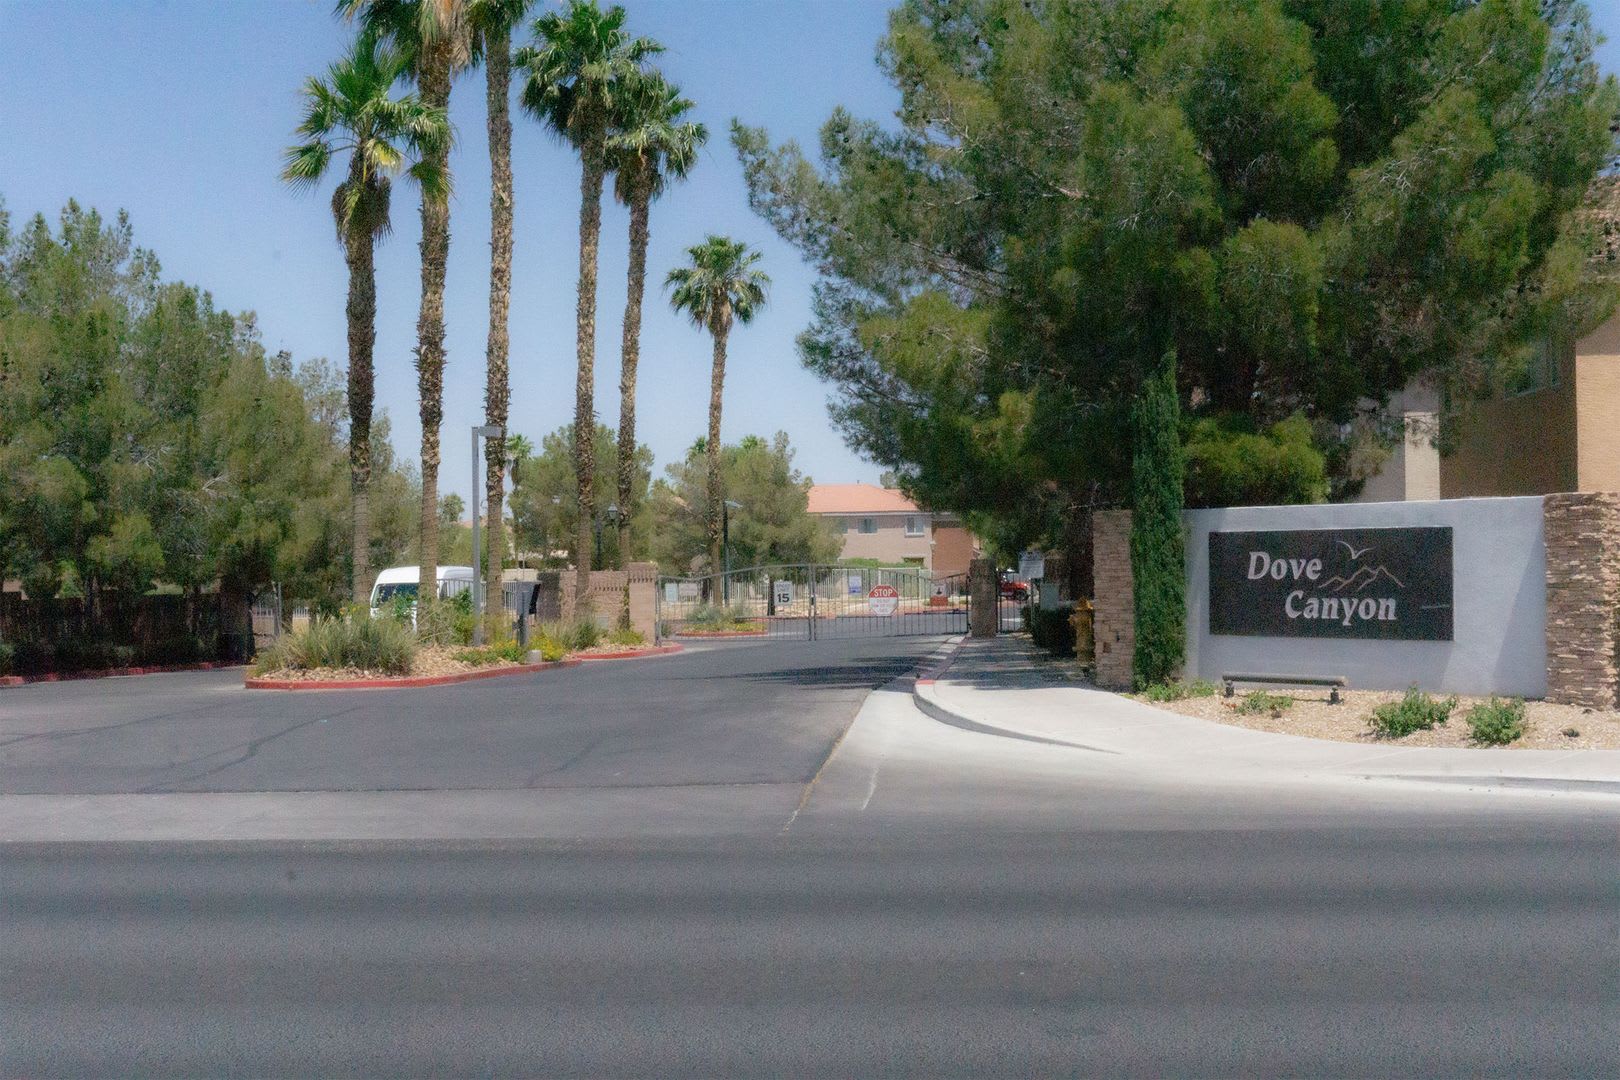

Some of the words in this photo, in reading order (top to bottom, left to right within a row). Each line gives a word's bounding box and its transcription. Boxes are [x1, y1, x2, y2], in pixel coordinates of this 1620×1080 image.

[1247, 551, 1323, 580] Dove
[777, 593, 790, 603] 15
[874, 588, 893, 597] STOP
[1284, 590, 1397, 626] Canyon
